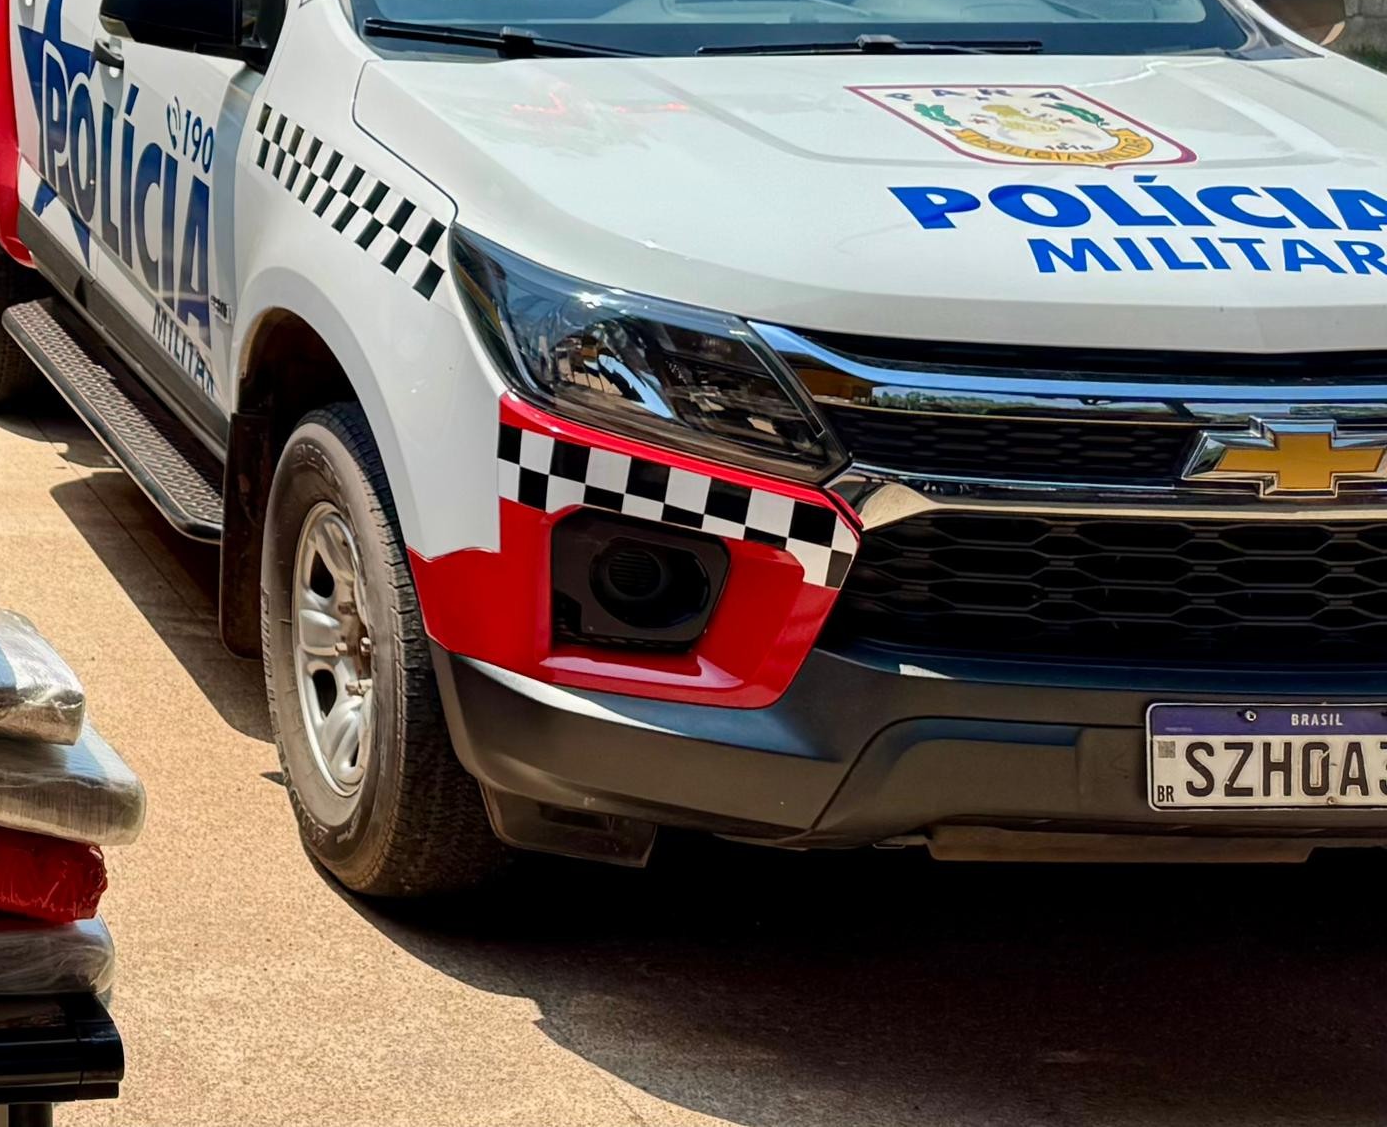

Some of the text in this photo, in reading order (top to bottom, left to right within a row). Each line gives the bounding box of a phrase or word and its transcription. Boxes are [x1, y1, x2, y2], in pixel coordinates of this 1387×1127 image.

[183, 109, 214, 174] 190
[42, 45, 213, 349] POLÍCIA
[888, 176, 1387, 231] POLÍCIA
[1027, 238, 1387, 274] MILITAR
[153, 301, 215, 394] MILITAR
[1291, 713, 1343, 726] BRASIL
[1157, 786, 1175, 802] BR
